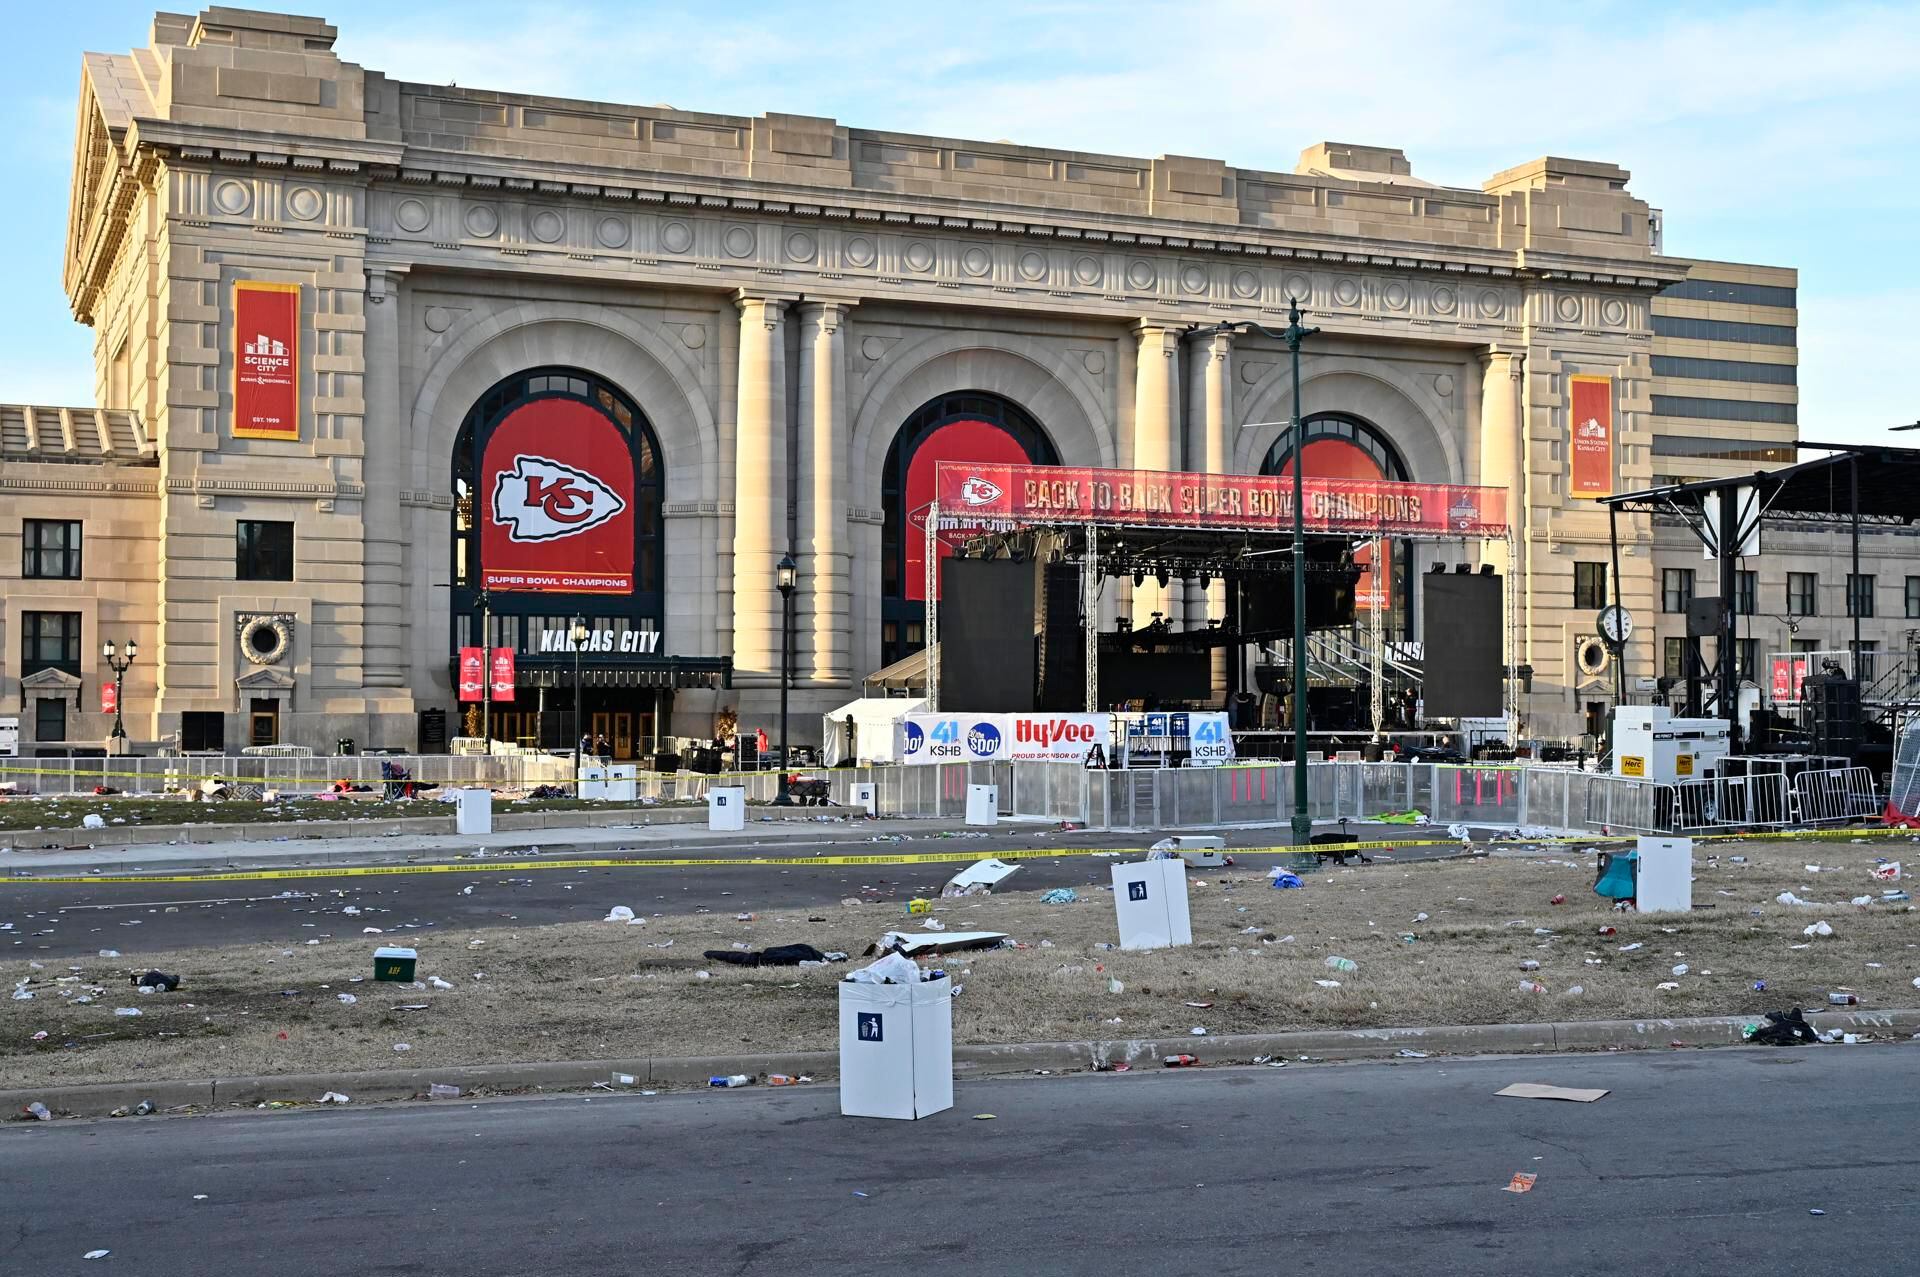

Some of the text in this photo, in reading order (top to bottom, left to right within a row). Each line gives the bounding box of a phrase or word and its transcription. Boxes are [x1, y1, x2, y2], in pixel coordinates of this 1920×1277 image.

[244, 356, 289, 366] SCIENCE
[523, 475, 594, 523] KC
[1024, 479, 1080, 509] BACK
[1120, 483, 1172, 513] BACK
[1180, 485, 1243, 516] SUPER
[1311, 490, 1422, 523] CHAMPIONS
[488, 575, 627, 587] SUPER BOWL CHAMPIONS
[620, 631, 660, 653] CITY
[931, 720, 958, 744] 41
[1195, 721, 1223, 744] 41
[930, 745, 961, 756] KSHB
[1195, 745, 1226, 757] KSHB
[1624, 760, 1641, 768] Herc
